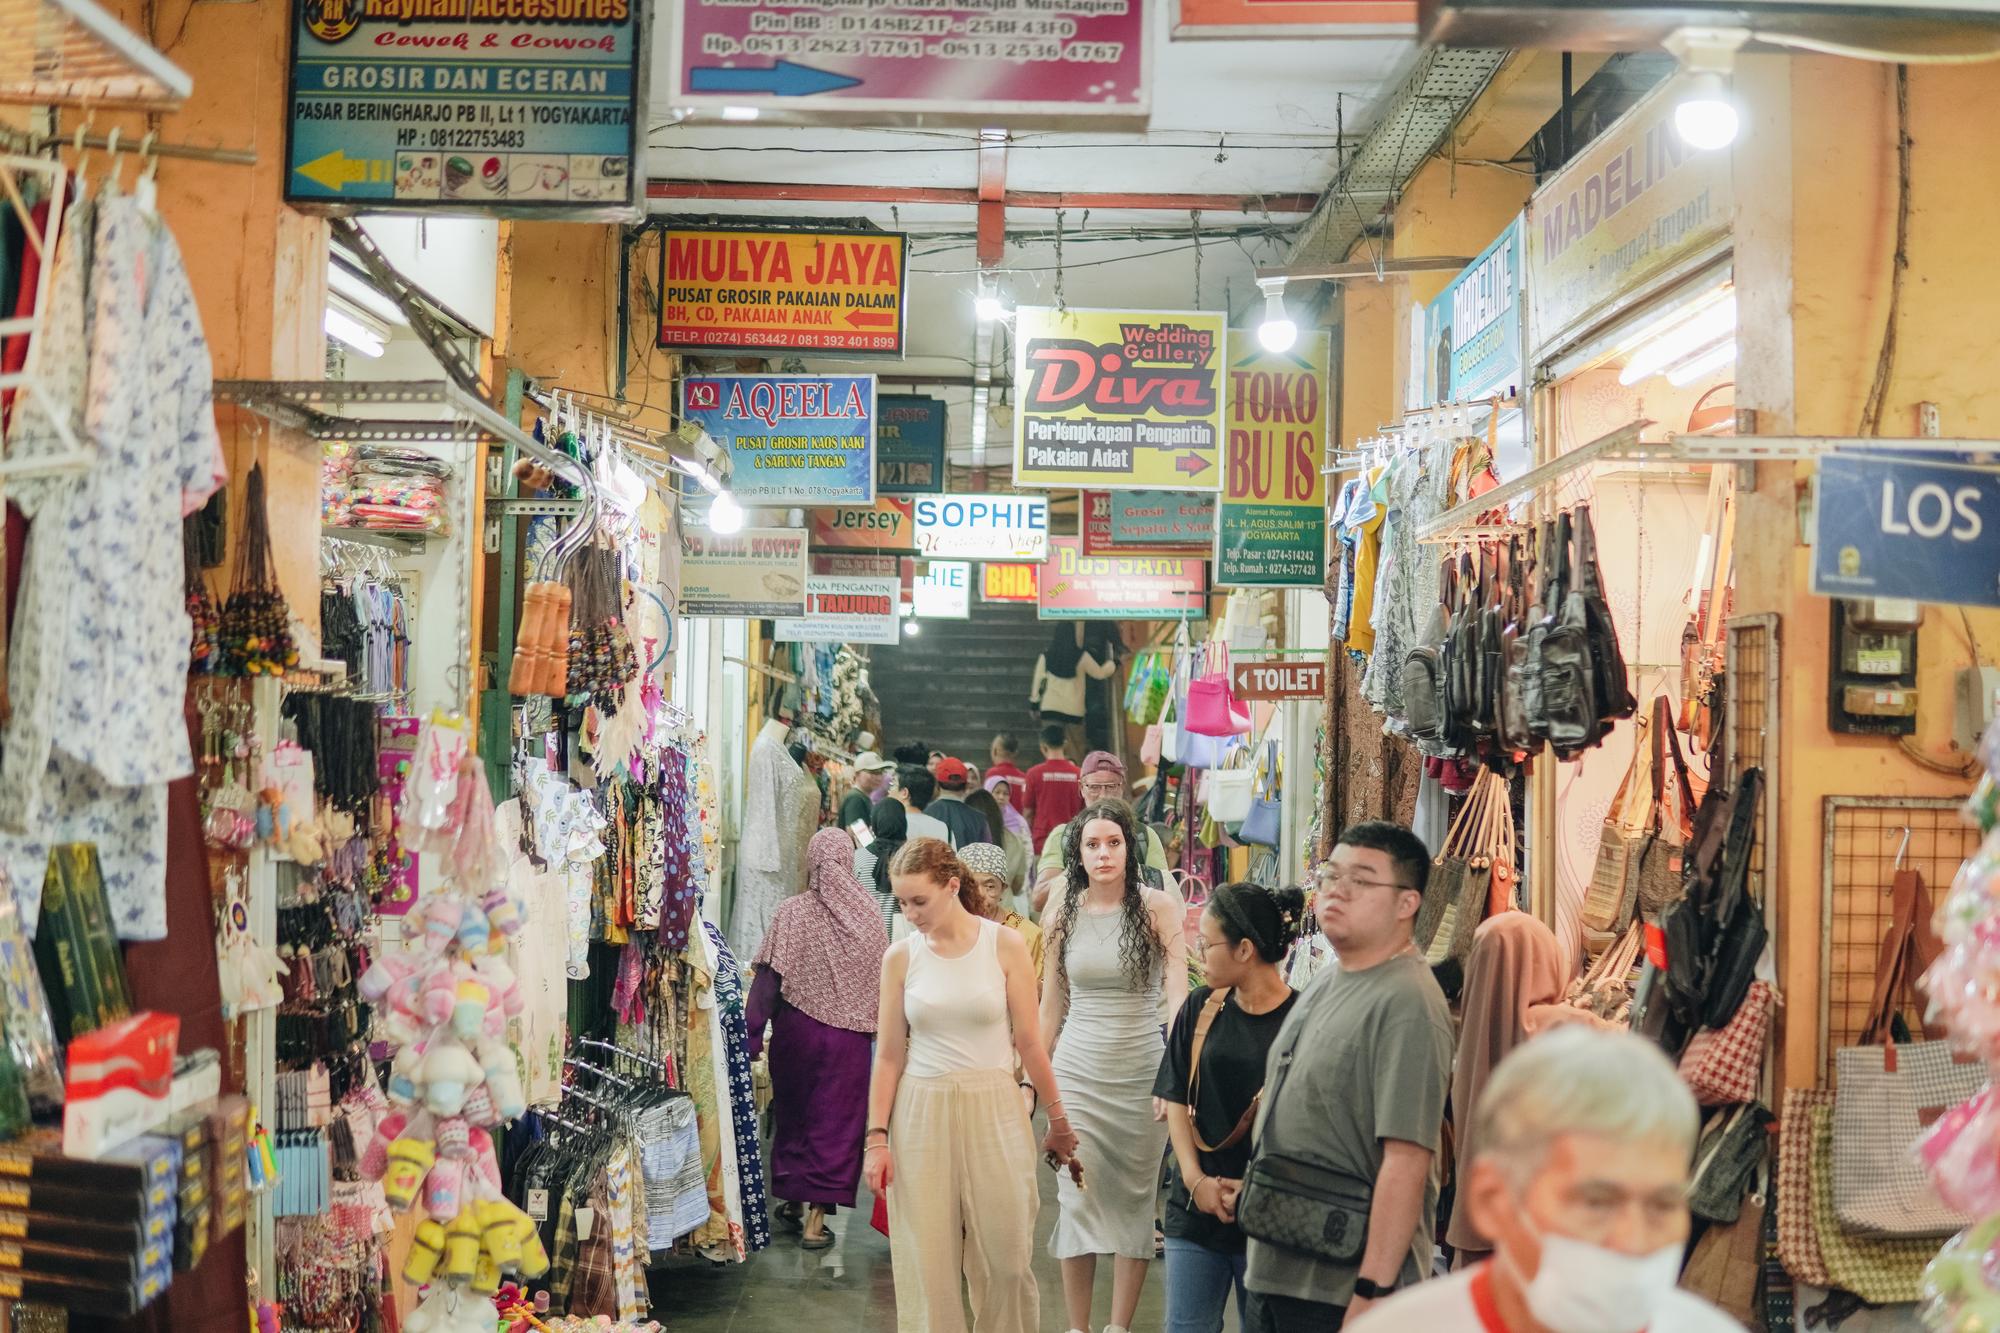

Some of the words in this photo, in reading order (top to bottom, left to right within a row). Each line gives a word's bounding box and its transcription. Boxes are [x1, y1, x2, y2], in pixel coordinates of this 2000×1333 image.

[754, 15, 786, 28] Pin
[794, 16, 821, 29] BB
[374, 31, 469, 50] Cewek
[480, 33, 499, 47] &
[511, 34, 616, 52] Cowok
[706, 38, 740, 53] Hp.
[746, 38, 799, 50] 0813
[808, 39, 861, 53] 2823
[870, 40, 921, 54] 7791
[943, 42, 997, 56] 0813
[1067, 46, 1121, 60] 4767
[322, 67, 425, 90] GROSIR
[434, 69, 488, 90] DAN
[497, 69, 608, 92] ECERAN
[296, 103, 343, 122] PASAR
[347, 103, 451, 123] BERINGHARJO
[456, 104, 477, 123] PB
[499, 106, 517, 124] Lt
[519, 106, 527, 123] 1
[531, 106, 630, 125] YOGYAKARTA
[397, 129, 417, 147] HP
[429, 130, 525, 148] 08122753483
[1543, 117, 1698, 266] MADELIN
[668, 238, 792, 283] MULYA
[804, 243, 897, 286] JAYA
[668, 288, 713, 303] PUSAT
[717, 289, 772, 305] GROSIR
[776, 291, 840, 307] PAKAIAN
[845, 293, 896, 308] DALAM
[1453, 234, 1512, 356] MADELINE
[667, 306, 690, 324] BH,
[696, 307, 718, 324] CD,
[724, 308, 788, 324] PAKAIAN
[792, 309, 833, 325] ANAK
[665, 330, 700, 344] TELP.
[703, 331, 741, 345] (0274)
[744, 332, 787, 345] 563442
[798, 334, 818, 346] 081
[823, 335, 844, 347] 392
[848, 336, 869, 347] 401
[872, 337, 895, 348] 899
[1124, 327, 1210, 348] Wedding
[1124, 345, 1210, 364] Gallery
[1031, 349, 1210, 406] Diva
[723, 381, 868, 428] AQEELA
[1230, 371, 1318, 425] TOKO
[735, 436, 768, 450] PUSAT
[770, 436, 809, 450] GROSIR
[811, 436, 837, 450] KAOS
[841, 436, 865, 450] KAKI
[1028, 421, 1133, 444] Perlengkapan
[1136, 423, 1211, 447] Pengantin
[753, 455, 762, 469] &
[764, 455, 805, 469] SARUNG
[807, 455, 847, 469] TANGAN
[1028, 447, 1088, 467] Pakaian
[1091, 448, 1128, 468] Adat
[1229, 428, 1273, 500] BU
[1284, 430, 1316, 502] IS
[759, 486, 770, 495] PB
[777, 486, 787, 495] LT
[823, 486, 864, 497] Yogyakarta
[916, 501, 1046, 529] SOPHIE
[1881, 479, 1983, 541] LOS
[832, 509, 902, 536] Jersey
[1251, 519, 1276, 529] AGUS
[1277, 520, 1304, 529] SALIM
[1241, 531, 1300, 541] YOGYAKARTA
[1243, 549, 1262, 560] Pasar
[1240, 563, 1264, 574] Rumah
[830, 583, 890, 592] PENGANTIN
[816, 593, 892, 615] TANJUNG
[1253, 668, 1321, 692] TOILET
